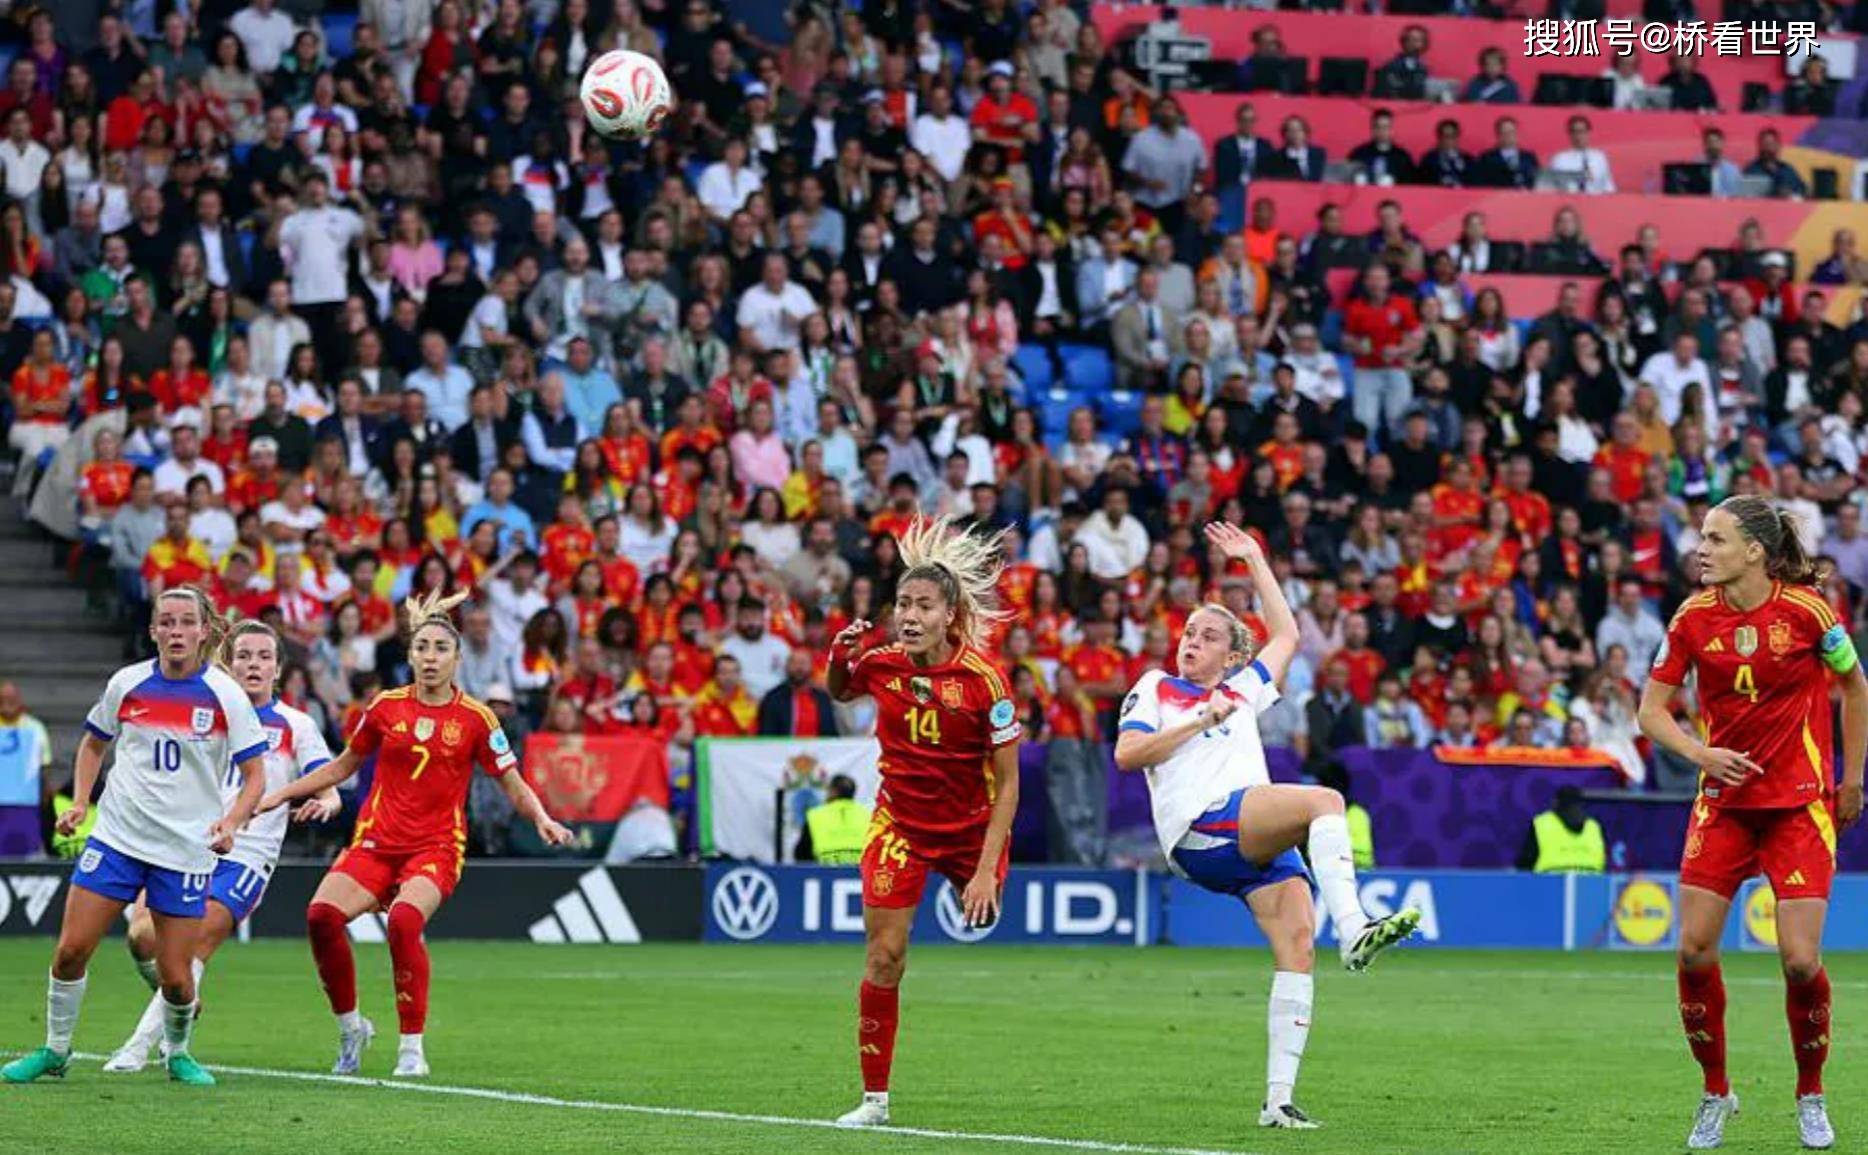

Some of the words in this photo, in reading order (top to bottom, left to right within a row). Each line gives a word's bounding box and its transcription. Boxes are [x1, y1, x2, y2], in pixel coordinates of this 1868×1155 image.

[1733, 664, 1758, 703] 4
[904, 706, 941, 744] 14
[154, 738, 181, 771] 10
[410, 744, 430, 780] 7
[880, 831, 910, 869] 14
[236, 867, 258, 897] 11
[1026, 881, 1133, 934] ID.
